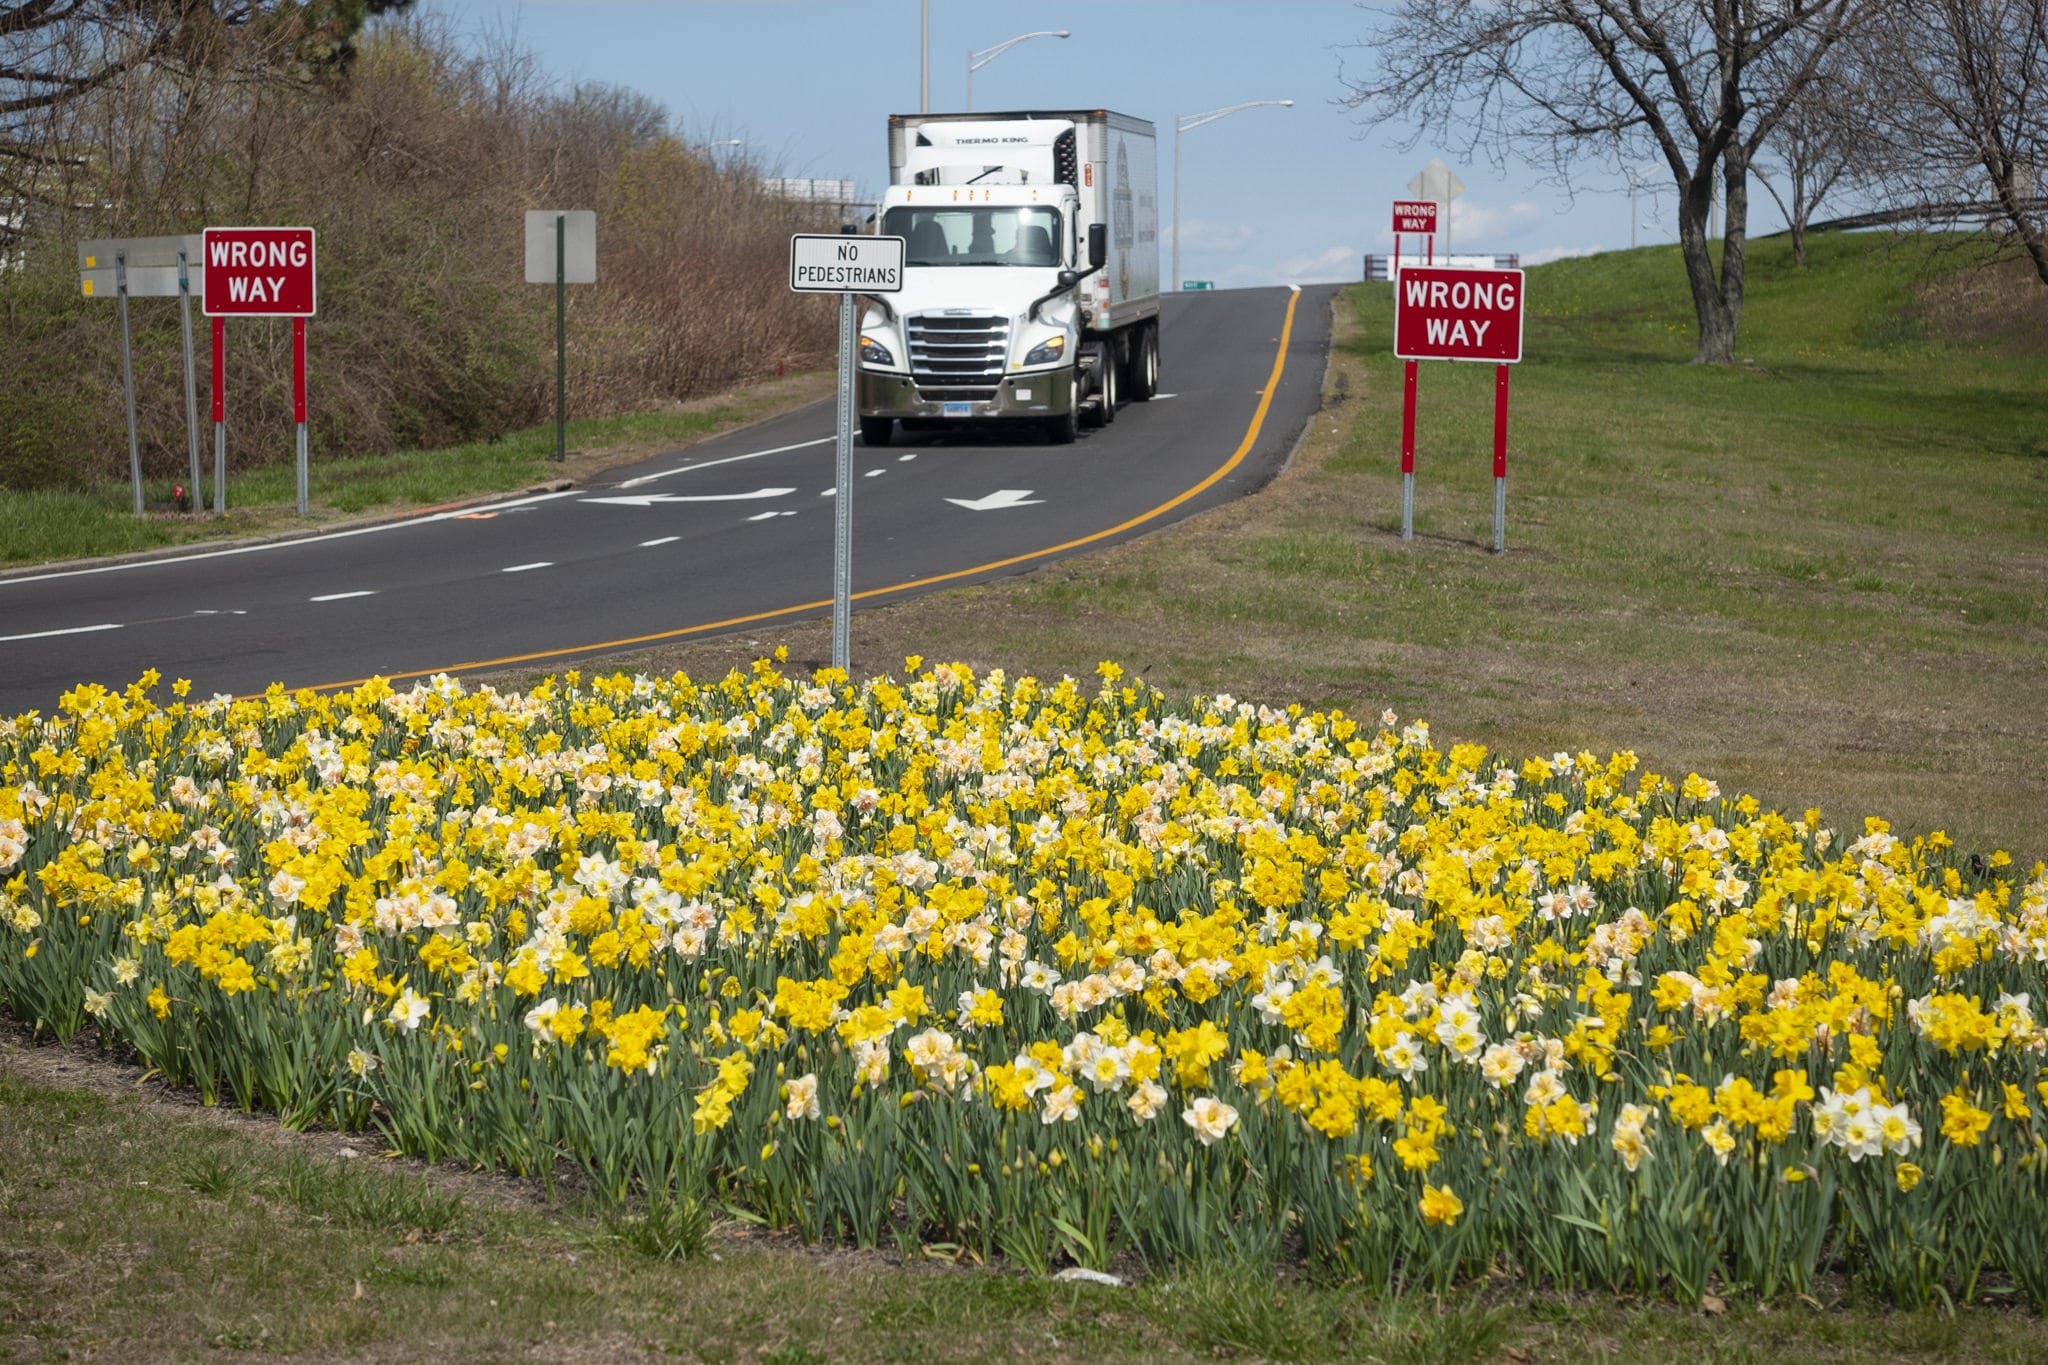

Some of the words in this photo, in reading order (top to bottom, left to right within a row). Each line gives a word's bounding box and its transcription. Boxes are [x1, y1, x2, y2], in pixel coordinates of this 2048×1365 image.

[956, 137, 999, 145] THERMO
[1395, 204, 1436, 217] WRONG
[1402, 218, 1427, 230] WAY
[210, 240, 307, 268] WRONG
[838, 245, 858, 261] NO
[798, 265, 896, 284] PEDESTRIANS
[228, 276, 286, 303] WAY
[1405, 279, 1515, 311] WRONG
[1426, 318, 1491, 347] WAY
